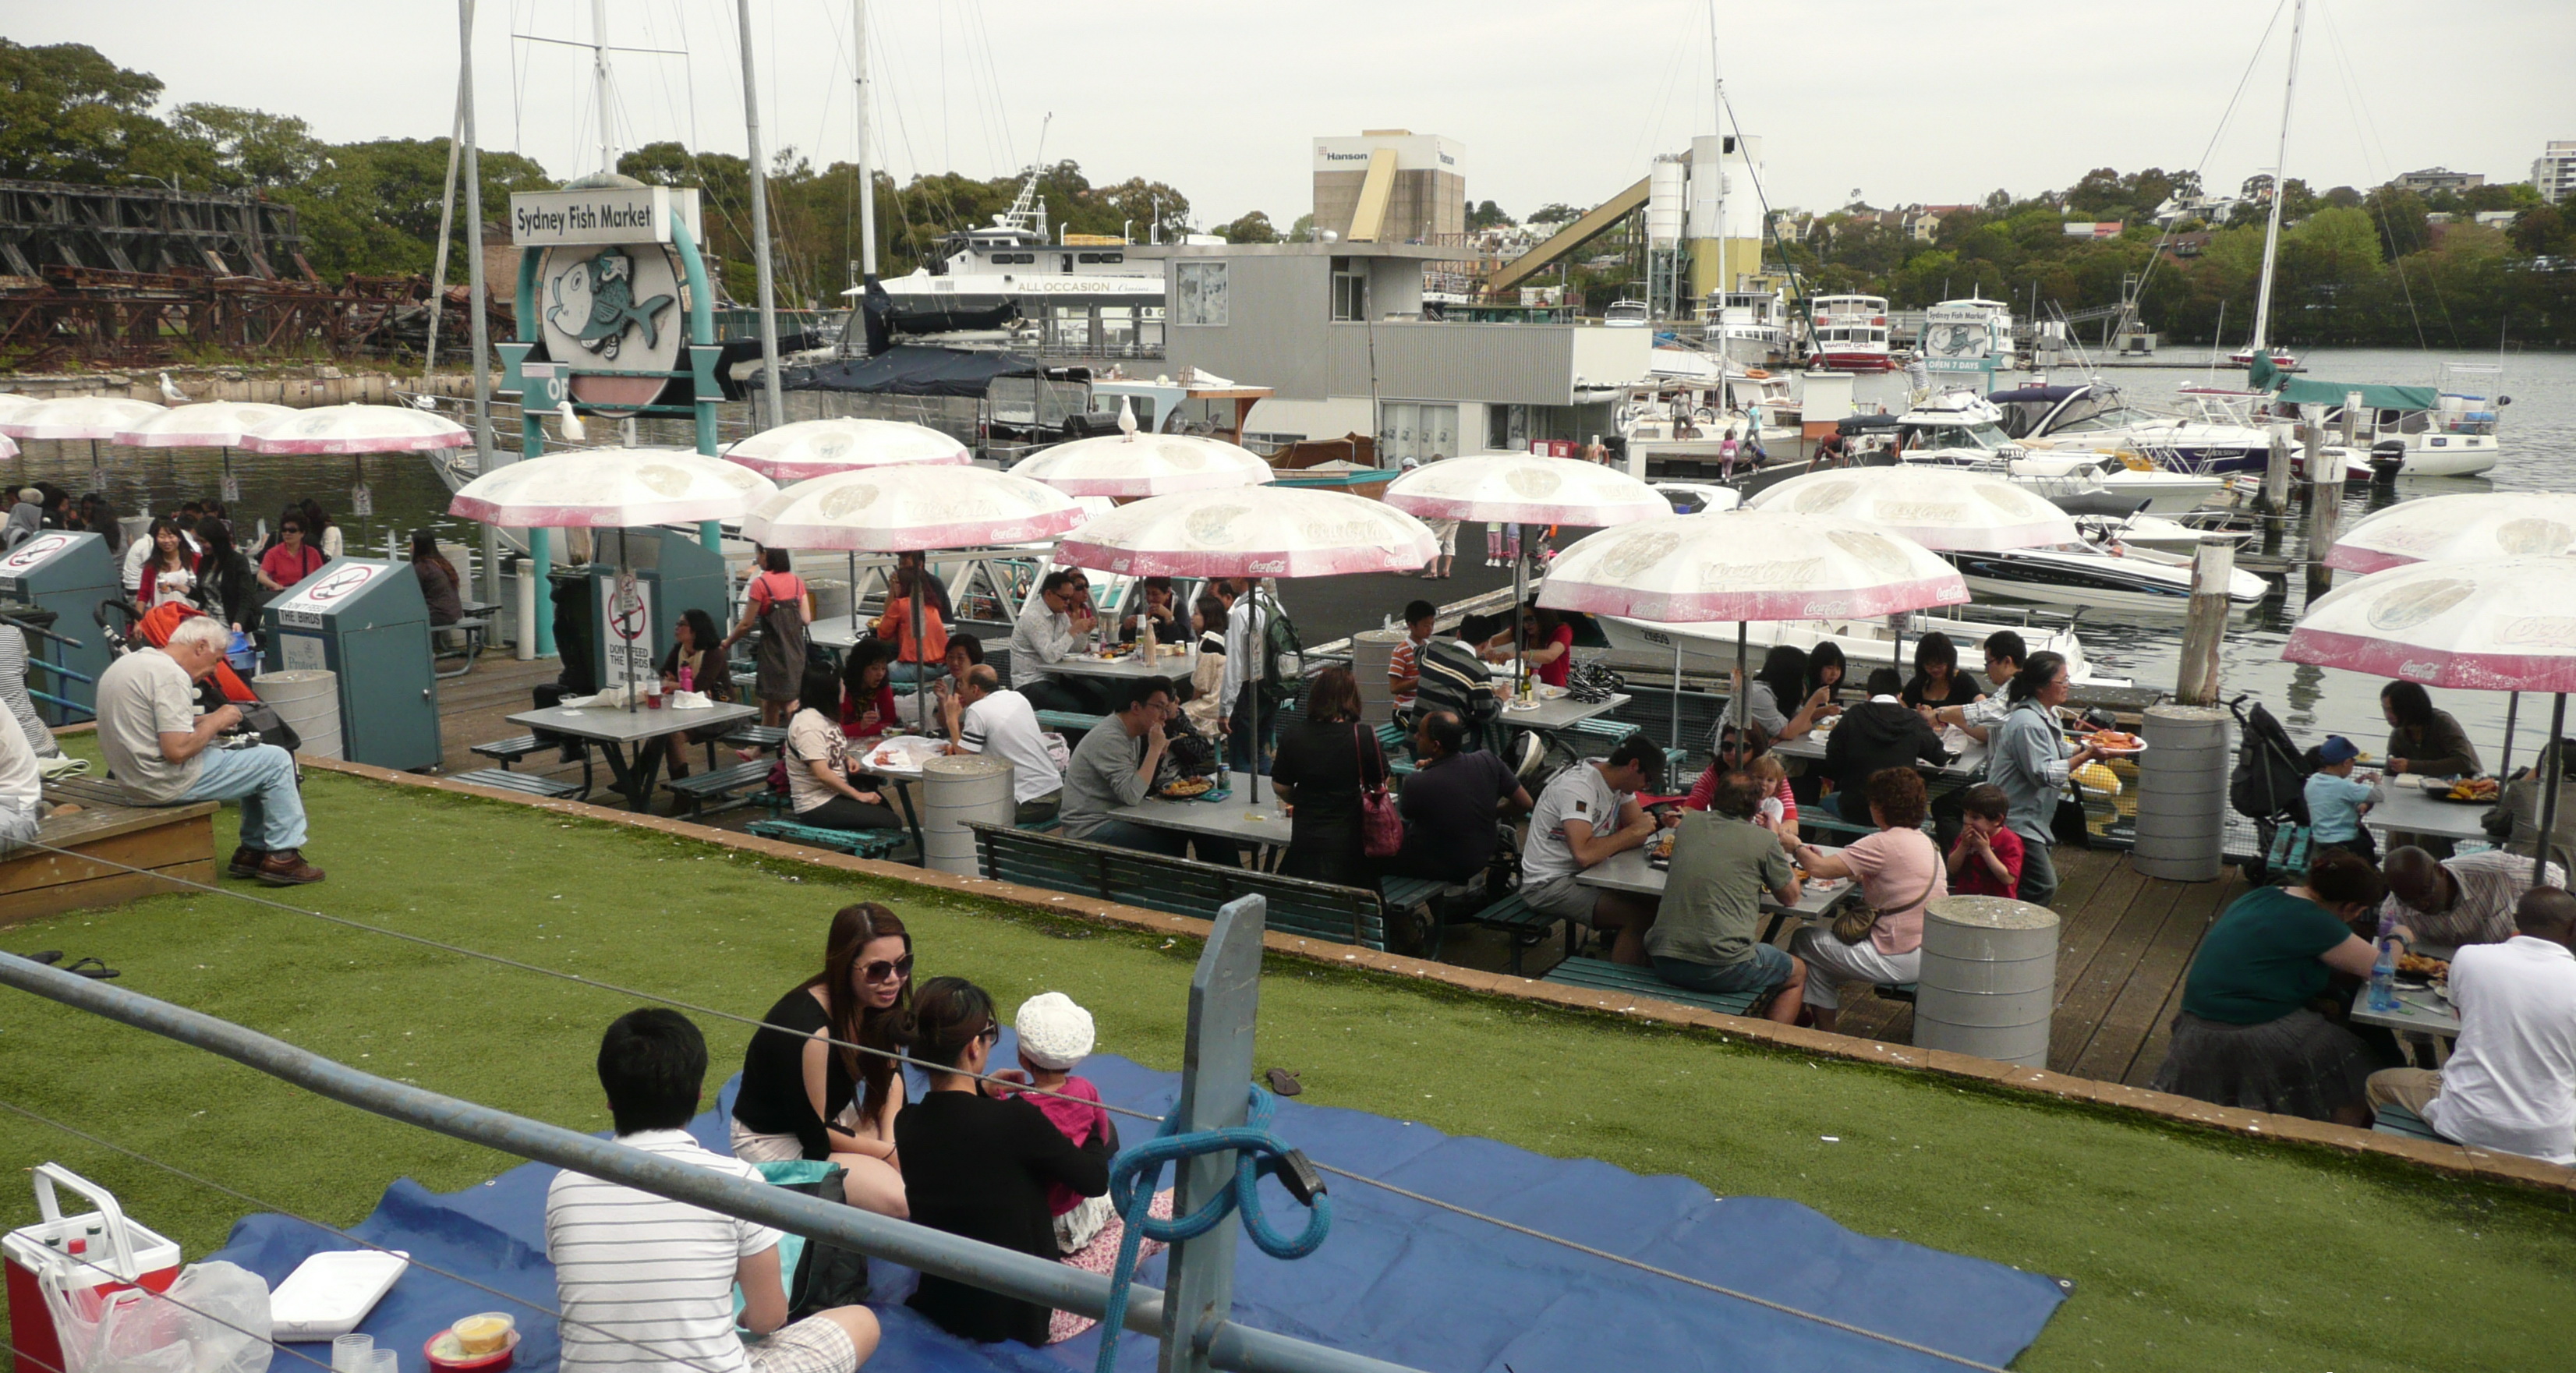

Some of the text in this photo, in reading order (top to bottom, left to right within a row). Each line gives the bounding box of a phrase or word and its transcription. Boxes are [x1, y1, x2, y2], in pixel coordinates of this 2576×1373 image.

[1327, 152, 1368, 161] Hanson
[518, 202, 650, 236] Sydney Fish Market
[1018, 282, 1042, 292] ALL
[1044, 282, 1110, 292] OCCASION
[1928, 310, 1950, 320] Sydney
[1951, 311, 1963, 320] Fish
[1959, 361, 1979, 370] DAYS
[1248, 560, 1286, 573] Coca-Cola
[1937, 585, 1963, 601] Coca-Cola
[1803, 600, 1849, 616] Coca-Cola
[279, 610, 320, 625] THE BIRDS
[610, 655, 625, 666] THE
